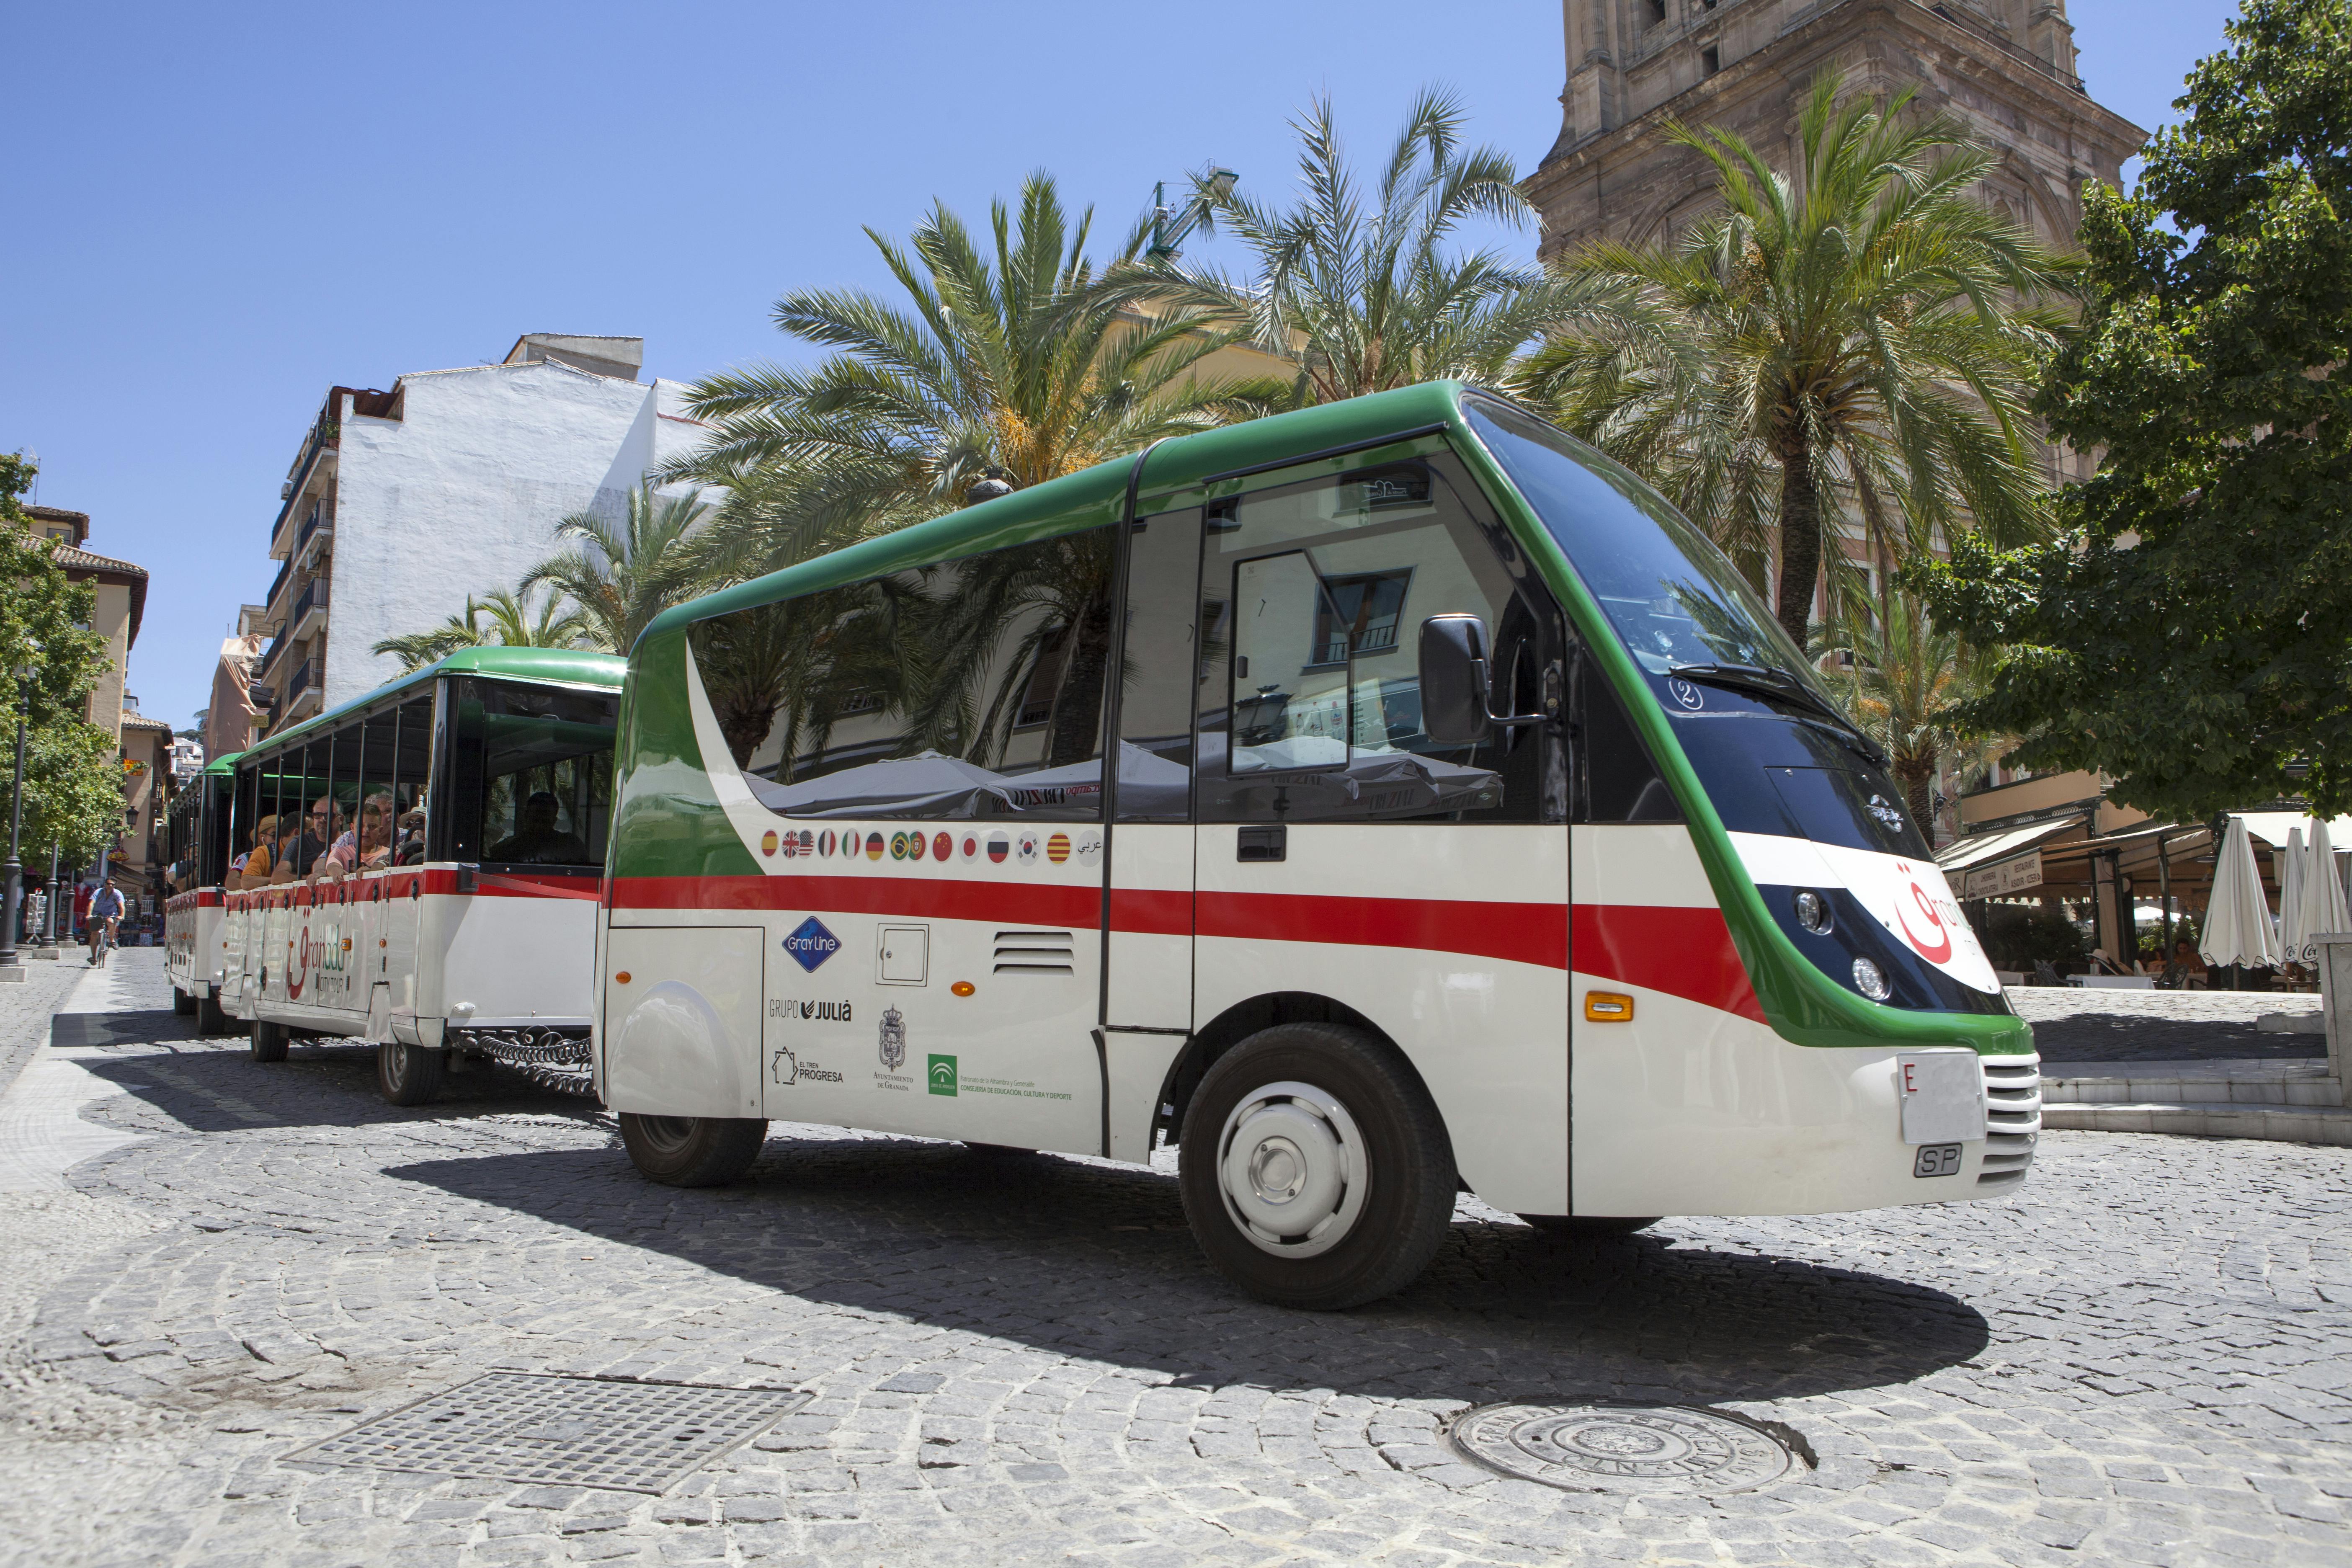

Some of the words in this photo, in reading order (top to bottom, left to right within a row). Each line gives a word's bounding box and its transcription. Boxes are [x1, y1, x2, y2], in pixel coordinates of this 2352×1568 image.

[1678, 680, 1694, 703] 2
[1078, 842, 1102, 854] عربي
[320, 977, 330, 992] CITY
[331, 977, 343, 994] TOUR
[770, 999, 798, 1018] GRUPO
[799, 1069, 843, 1083] PROGRESA
[1905, 1064, 1917, 1091] E
[1921, 1148, 1957, 1173] SP
[1477, 1404, 1598, 1443] GRANADA
